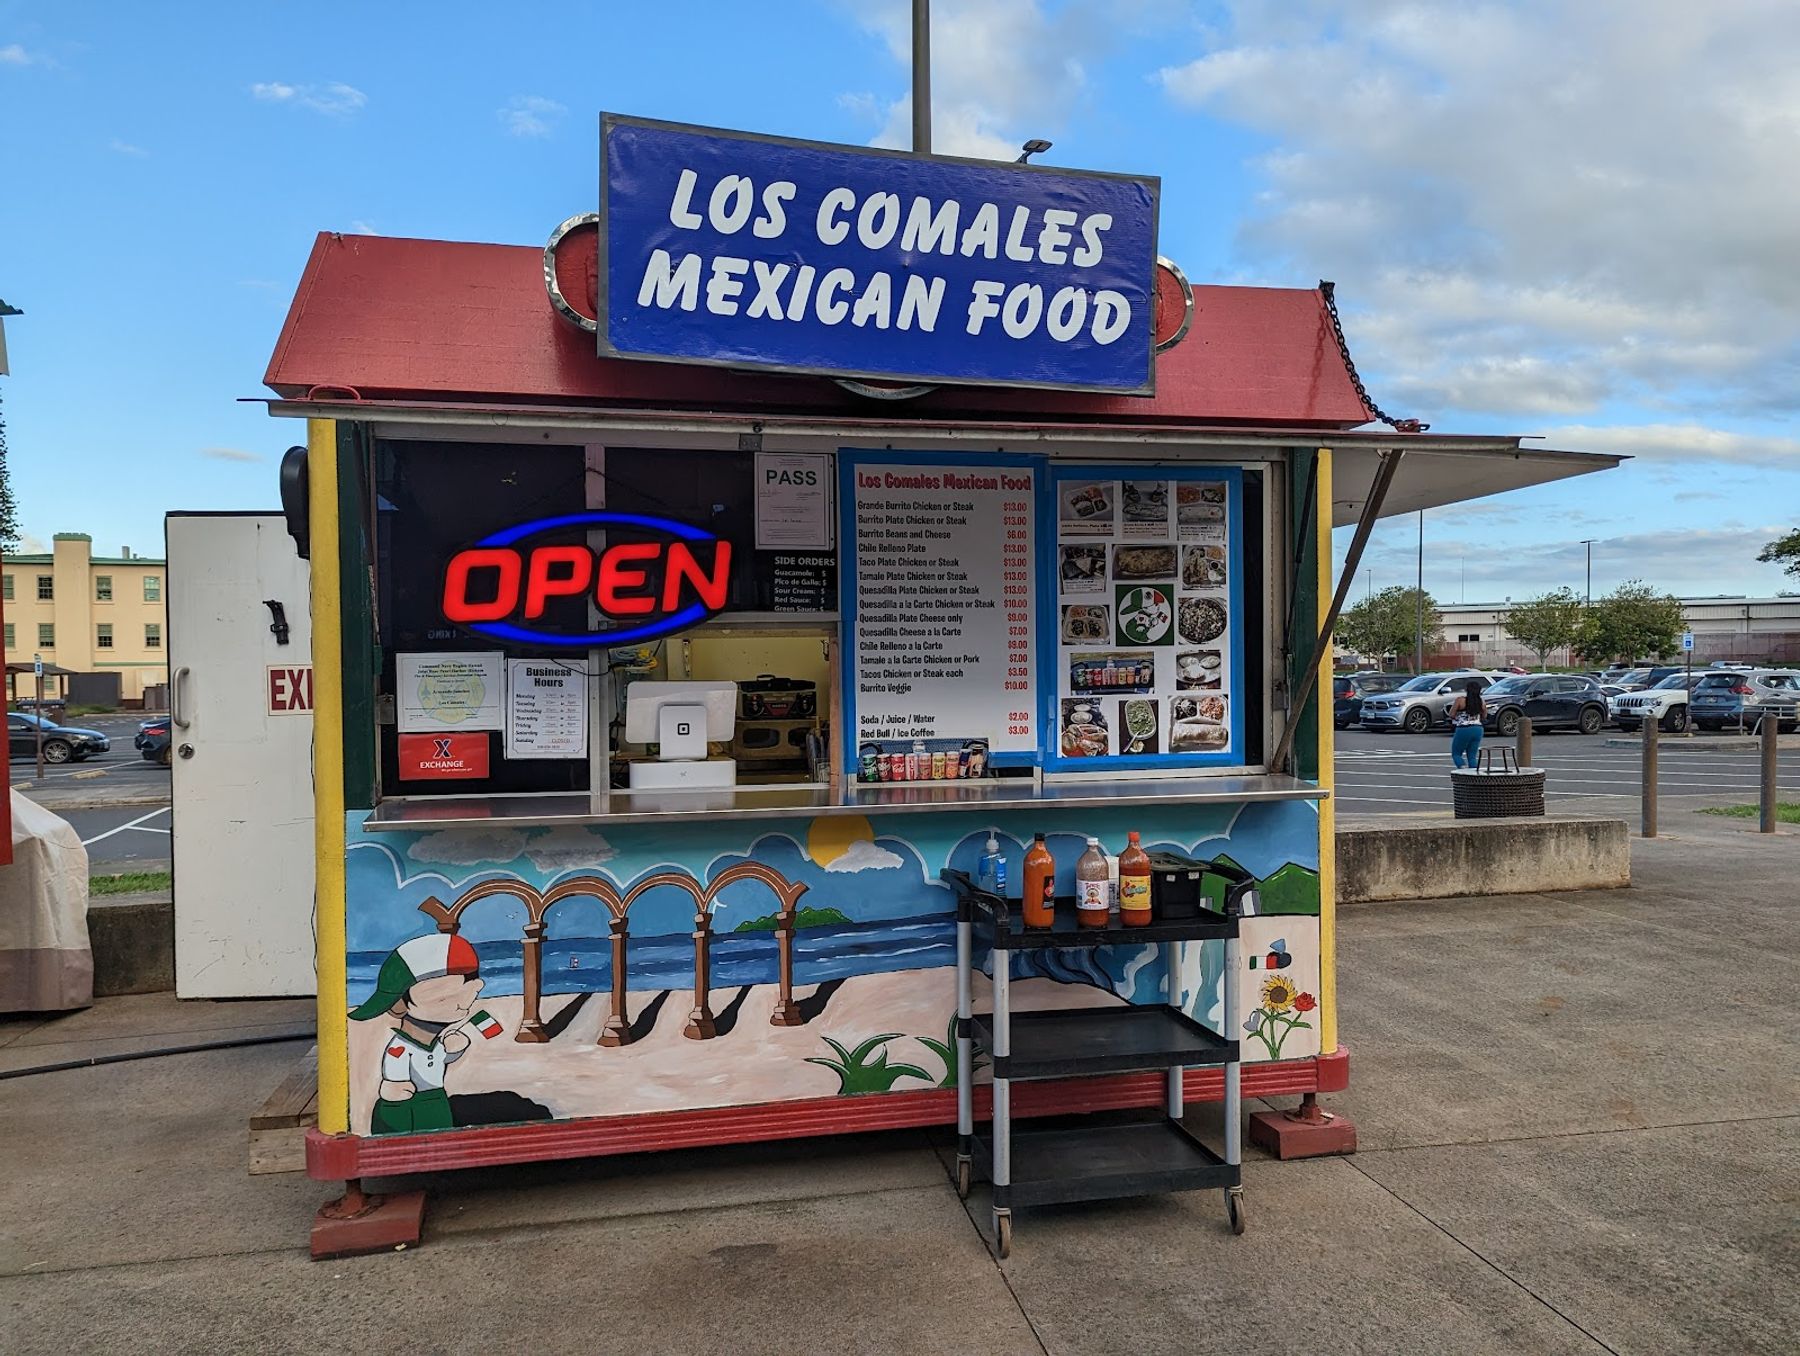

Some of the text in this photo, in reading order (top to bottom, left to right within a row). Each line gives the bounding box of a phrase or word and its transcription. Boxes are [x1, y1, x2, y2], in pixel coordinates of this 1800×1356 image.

[670, 168, 1112, 268] LOS COMALES
[637, 248, 1132, 346] MEXICAN FOOD
[766, 469, 817, 485] PASS
[858, 472, 1031, 490] Los Comales Mexican Food
[858, 501, 884, 510] Grande
[886, 502, 911, 510] Burrito
[913, 502, 942, 511] Chicken
[952, 502, 974, 511] Steak
[858, 515, 883, 524] Burrito
[886, 515, 904, 524] Plate
[906, 516, 935, 524] Chicken
[945, 516, 967, 525] Steak
[858, 530, 884, 538] Burrito
[886, 530, 907, 538] Beans
[909, 530, 923, 538] and
[925, 530, 951, 539] Cheese
[858, 544, 877, 552] Chile
[879, 544, 906, 552] Relleno
[907, 544, 926, 552] Plate
[774, 556, 835, 566] SIDE ORDERS
[859, 558, 876, 566] Taco
[877, 558, 896, 567] Plate
[898, 558, 927, 567] Chicken
[938, 558, 959, 567] Steak
[442, 540, 732, 623] OPEN
[859, 572, 885, 581] Tamale
[886, 572, 905, 581] Plate
[907, 572, 936, 581] Chicken
[946, 572, 967, 581] Steak
[859, 586, 897, 596] Quesadilla
[899, 586, 917, 594] Plate
[919, 586, 948, 594] Chicken
[958, 586, 979, 595] Steak
[859, 600, 897, 609] Quesadilla
[899, 601, 903, 609] a
[905, 600, 912, 608] la
[913, 599, 934, 608] Carte
[935, 599, 964, 608] Chicken
[975, 599, 995, 608] Steak
[859, 614, 898, 624] Quesadilla
[899, 614, 918, 623] Plate
[920, 614, 945, 622] Cheese
[947, 613, 963, 624] only
[859, 628, 898, 637] Quesadilla
[899, 628, 926, 636] Cheese
[934, 627, 941, 636] la
[942, 627, 961, 636] Carte
[860, 642, 878, 651] Chile
[880, 642, 907, 650] Relleno
[915, 642, 921, 650] la
[923, 642, 943, 650] Carte
[860, 656, 886, 665] Tamale
[893, 656, 901, 664] la
[902, 656, 922, 664] Carte
[924, 656, 953, 664] Chicken
[963, 655, 980, 663] Pork
[526, 667, 572, 677] Business
[860, 670, 882, 679] Tacos
[883, 670, 912, 678] Chicken
[923, 669, 944, 678] Steak
[534, 677, 564, 688] Hours
[270, 669, 313, 711] EXI
[860, 684, 886, 693] Burrito
[887, 684, 912, 694] Veggie
[860, 715, 879, 724] Soda
[881, 715, 885, 724] /
[886, 715, 906, 724] Juice
[908, 715, 912, 724] /
[913, 715, 935, 723] Water
[860, 730, 875, 738] Red
[877, 730, 890, 738] Bull
[897, 729, 909, 737] Ice
[911, 729, 935, 737] Coffee
[420, 761, 464, 769] EXCHANGE
